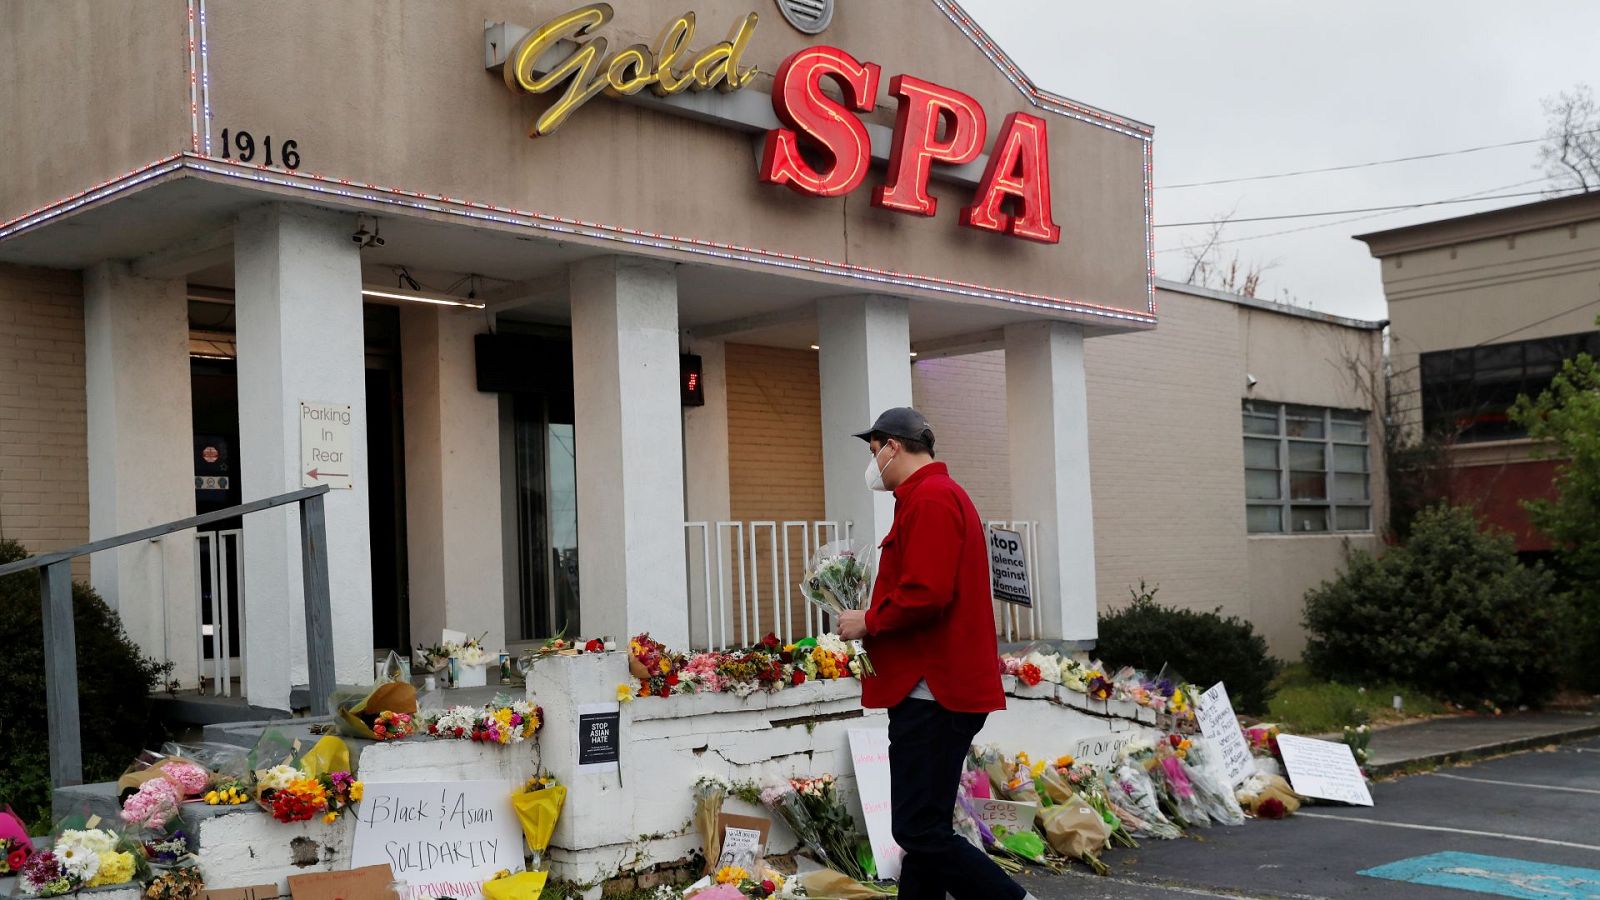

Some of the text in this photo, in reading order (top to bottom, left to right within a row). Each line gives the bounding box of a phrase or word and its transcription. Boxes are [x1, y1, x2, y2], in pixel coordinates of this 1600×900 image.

[504, 3, 1061, 245] Gold SPA
[221, 128, 300, 170] 1916
[303, 405, 351, 426] Parking
[321, 427, 334, 442] In
[312, 447, 344, 463] Rear
[991, 530, 1018, 556] top
[992, 551, 1024, 568] iolence
[590, 729, 610, 737] ASIAN
[591, 722, 608, 730] STOP
[591, 736, 608, 744] HATE
[1074, 740, 1090, 760] In
[1094, 741, 1112, 756] our
[364, 795, 429, 829] Black
[449, 792, 494, 830] Asian
[983, 802, 1017, 812] GOD
[385, 838, 499, 874] SOLIDARITY
